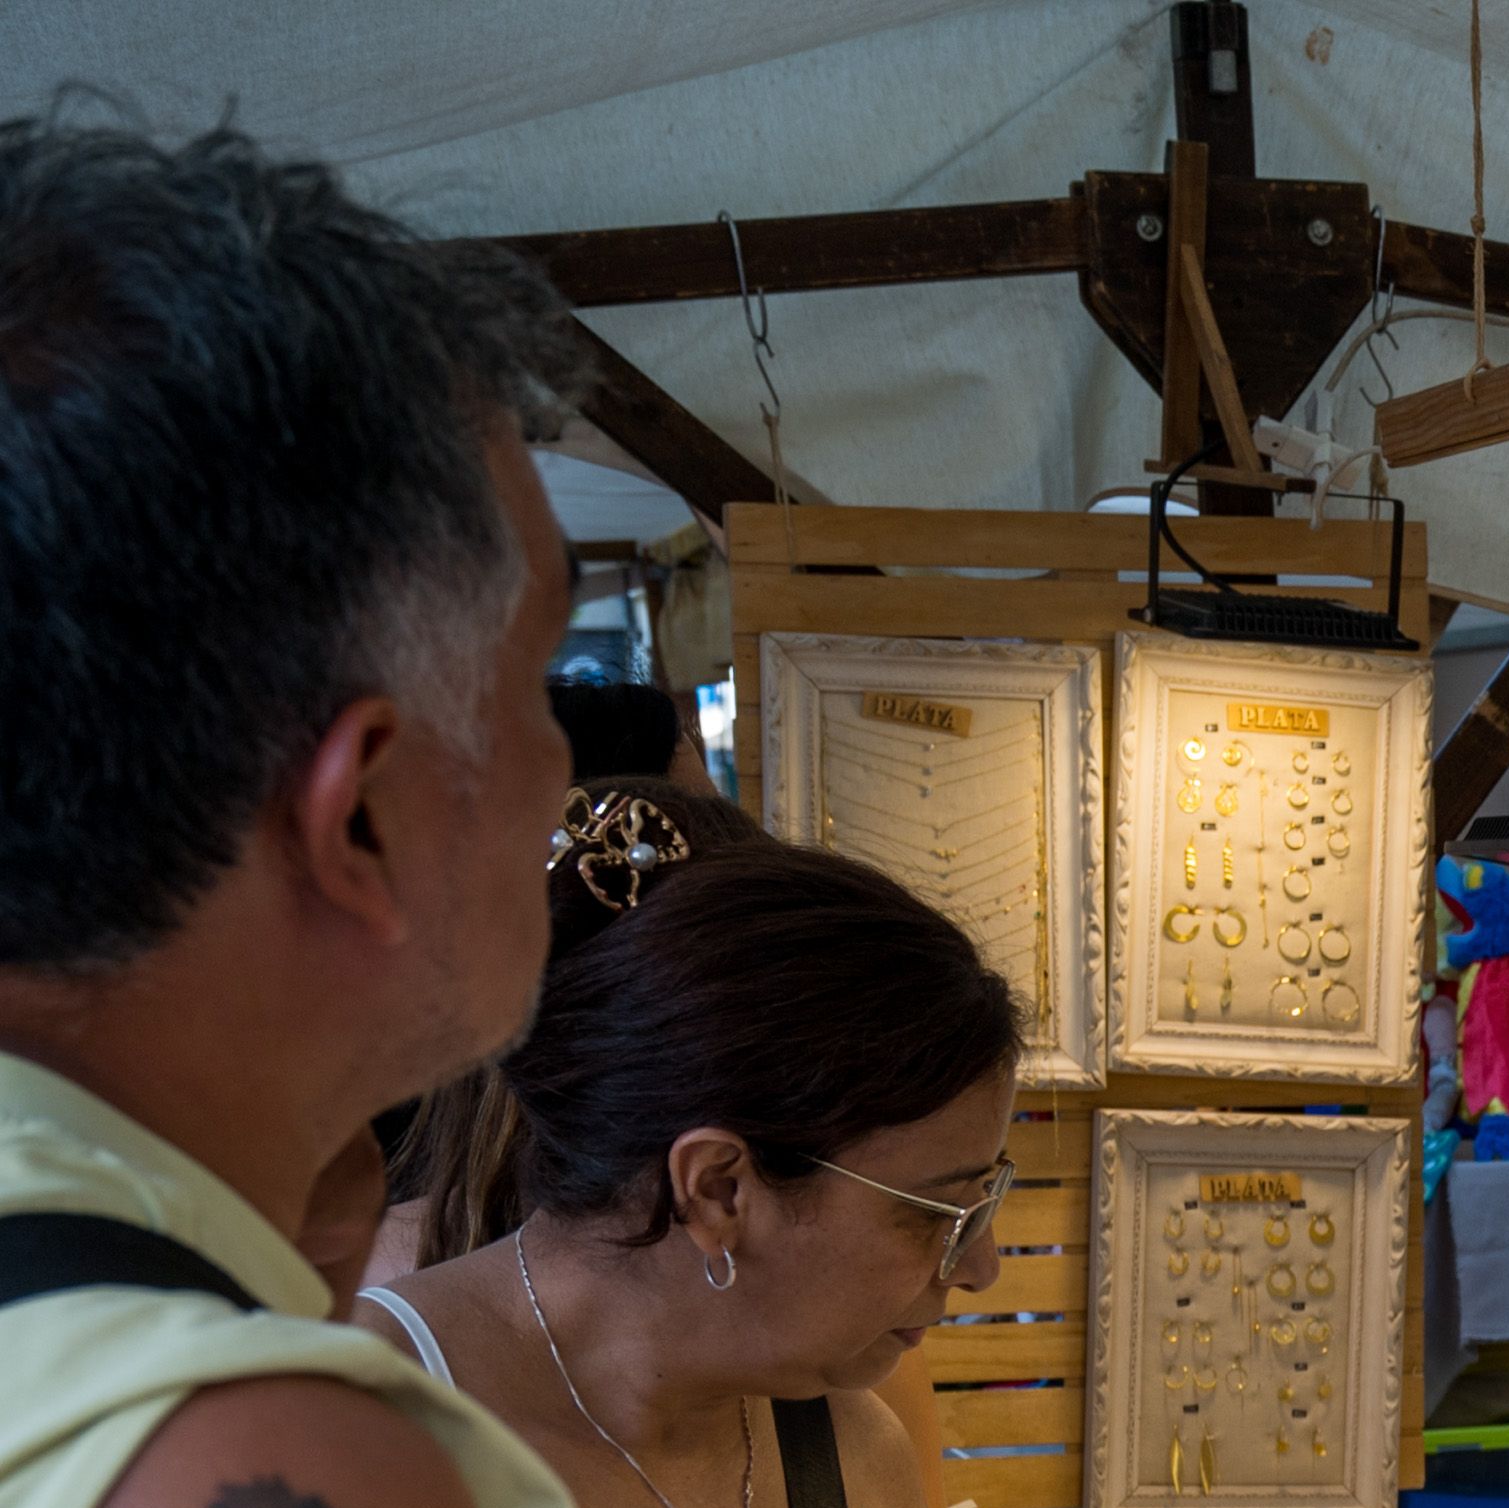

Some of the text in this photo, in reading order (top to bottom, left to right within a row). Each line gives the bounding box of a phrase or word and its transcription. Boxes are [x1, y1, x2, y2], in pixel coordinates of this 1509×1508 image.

[875, 696, 955, 730] PLATA
[1240, 704, 1320, 732] PLATA
[1210, 1178, 1291, 1200] PLATA
